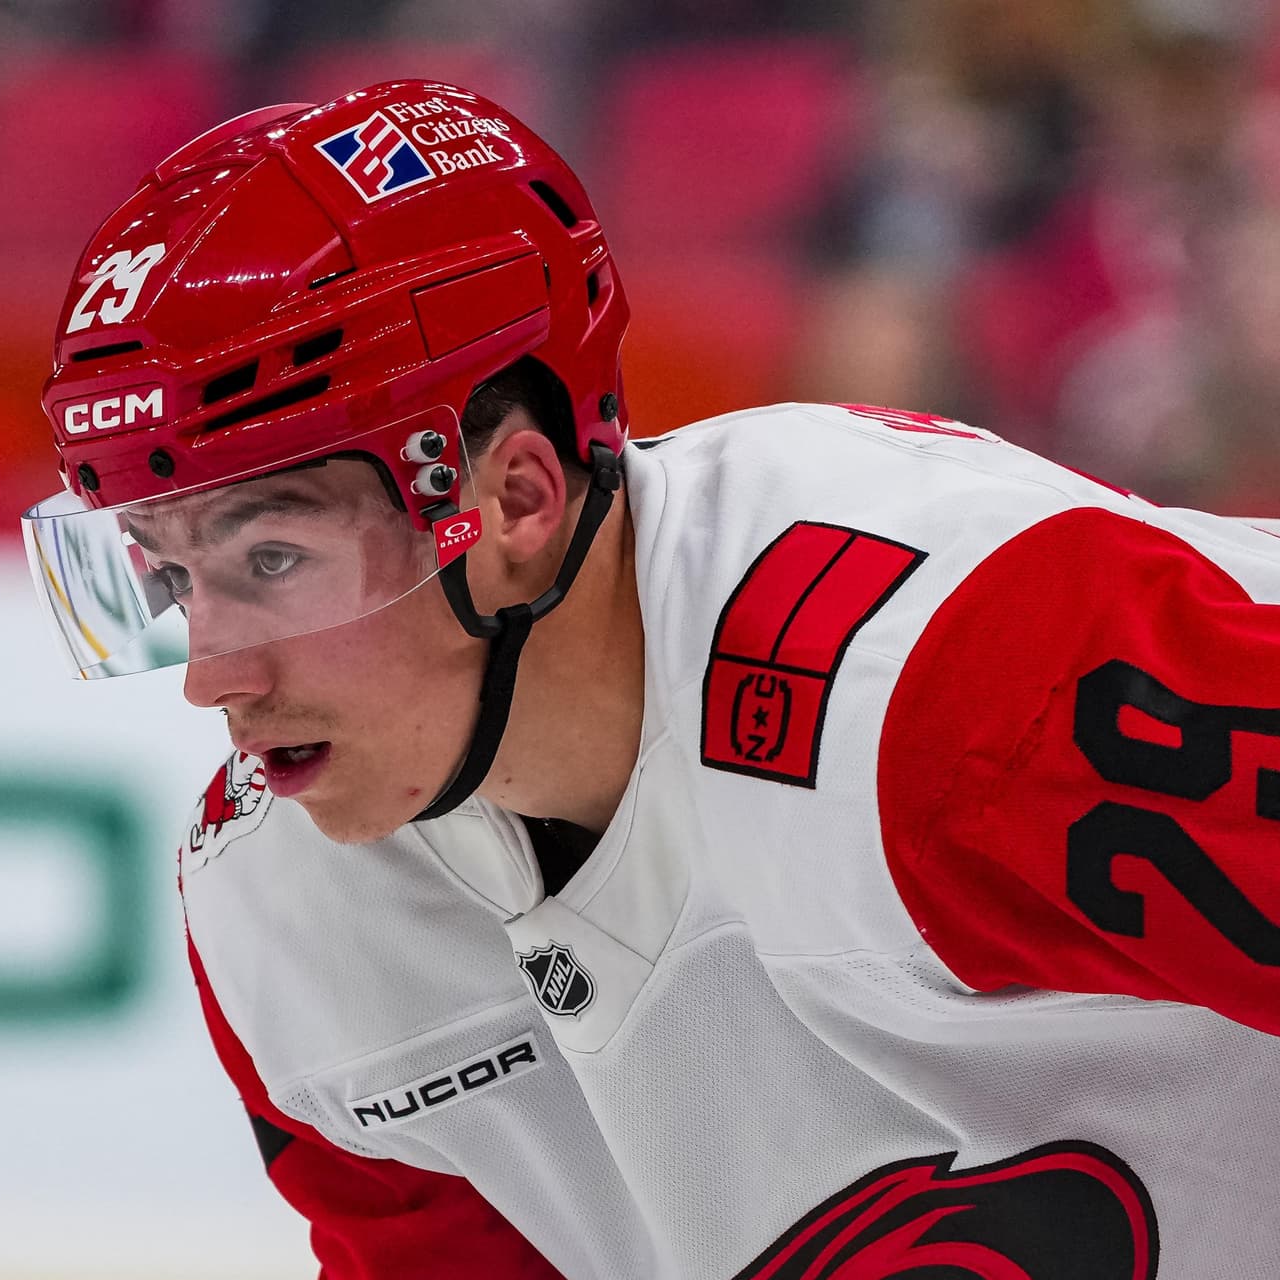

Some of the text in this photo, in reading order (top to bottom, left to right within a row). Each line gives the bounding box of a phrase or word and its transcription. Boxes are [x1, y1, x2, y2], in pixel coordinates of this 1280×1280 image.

[384, 97, 452, 123] First
[411, 117, 510, 146] Citizens
[428, 138, 504, 176] Bank
[66, 242, 166, 335] 29
[64, 388, 164, 435] CCM
[440, 529, 480, 549] OAKLEY
[546, 957, 573, 1008] NHL
[352, 1041, 539, 1128] NUCOR
